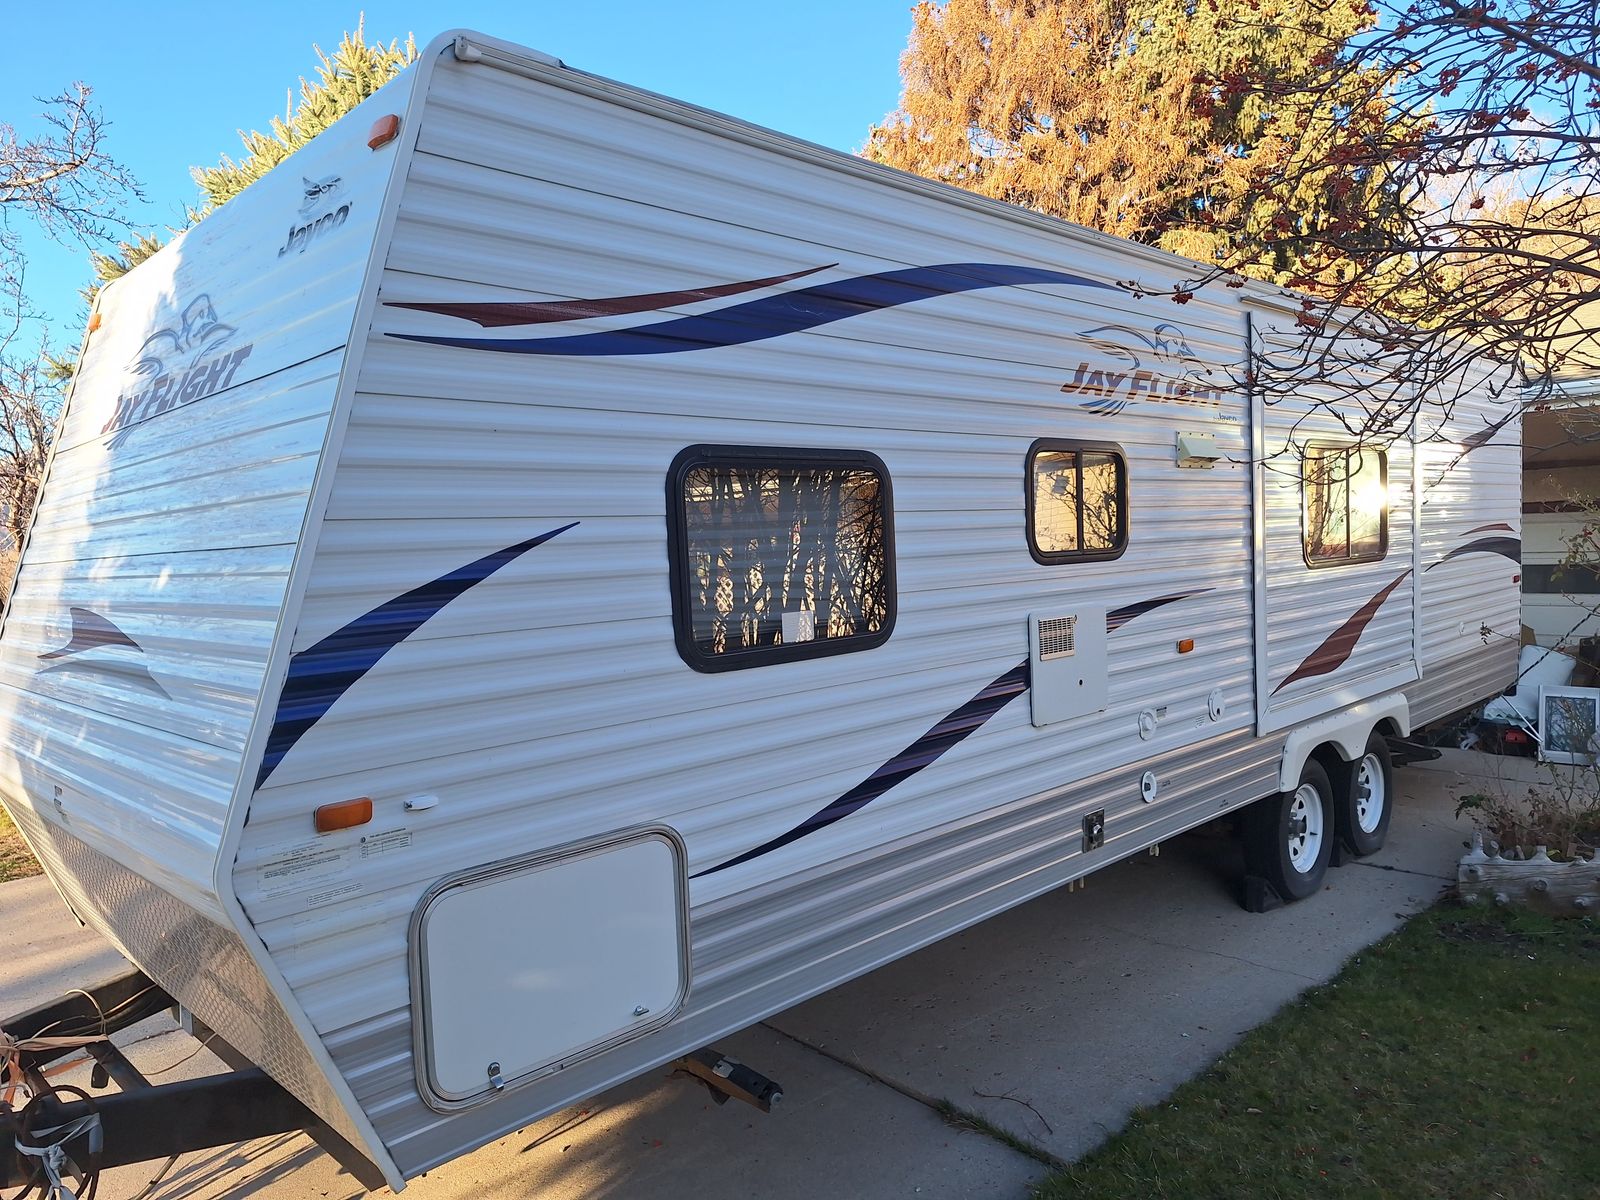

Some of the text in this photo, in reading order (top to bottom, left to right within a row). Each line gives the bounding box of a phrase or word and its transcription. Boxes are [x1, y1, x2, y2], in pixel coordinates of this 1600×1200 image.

[101, 344, 253, 434] JAY FLIGHT
[1060, 362, 1128, 397] JAY
